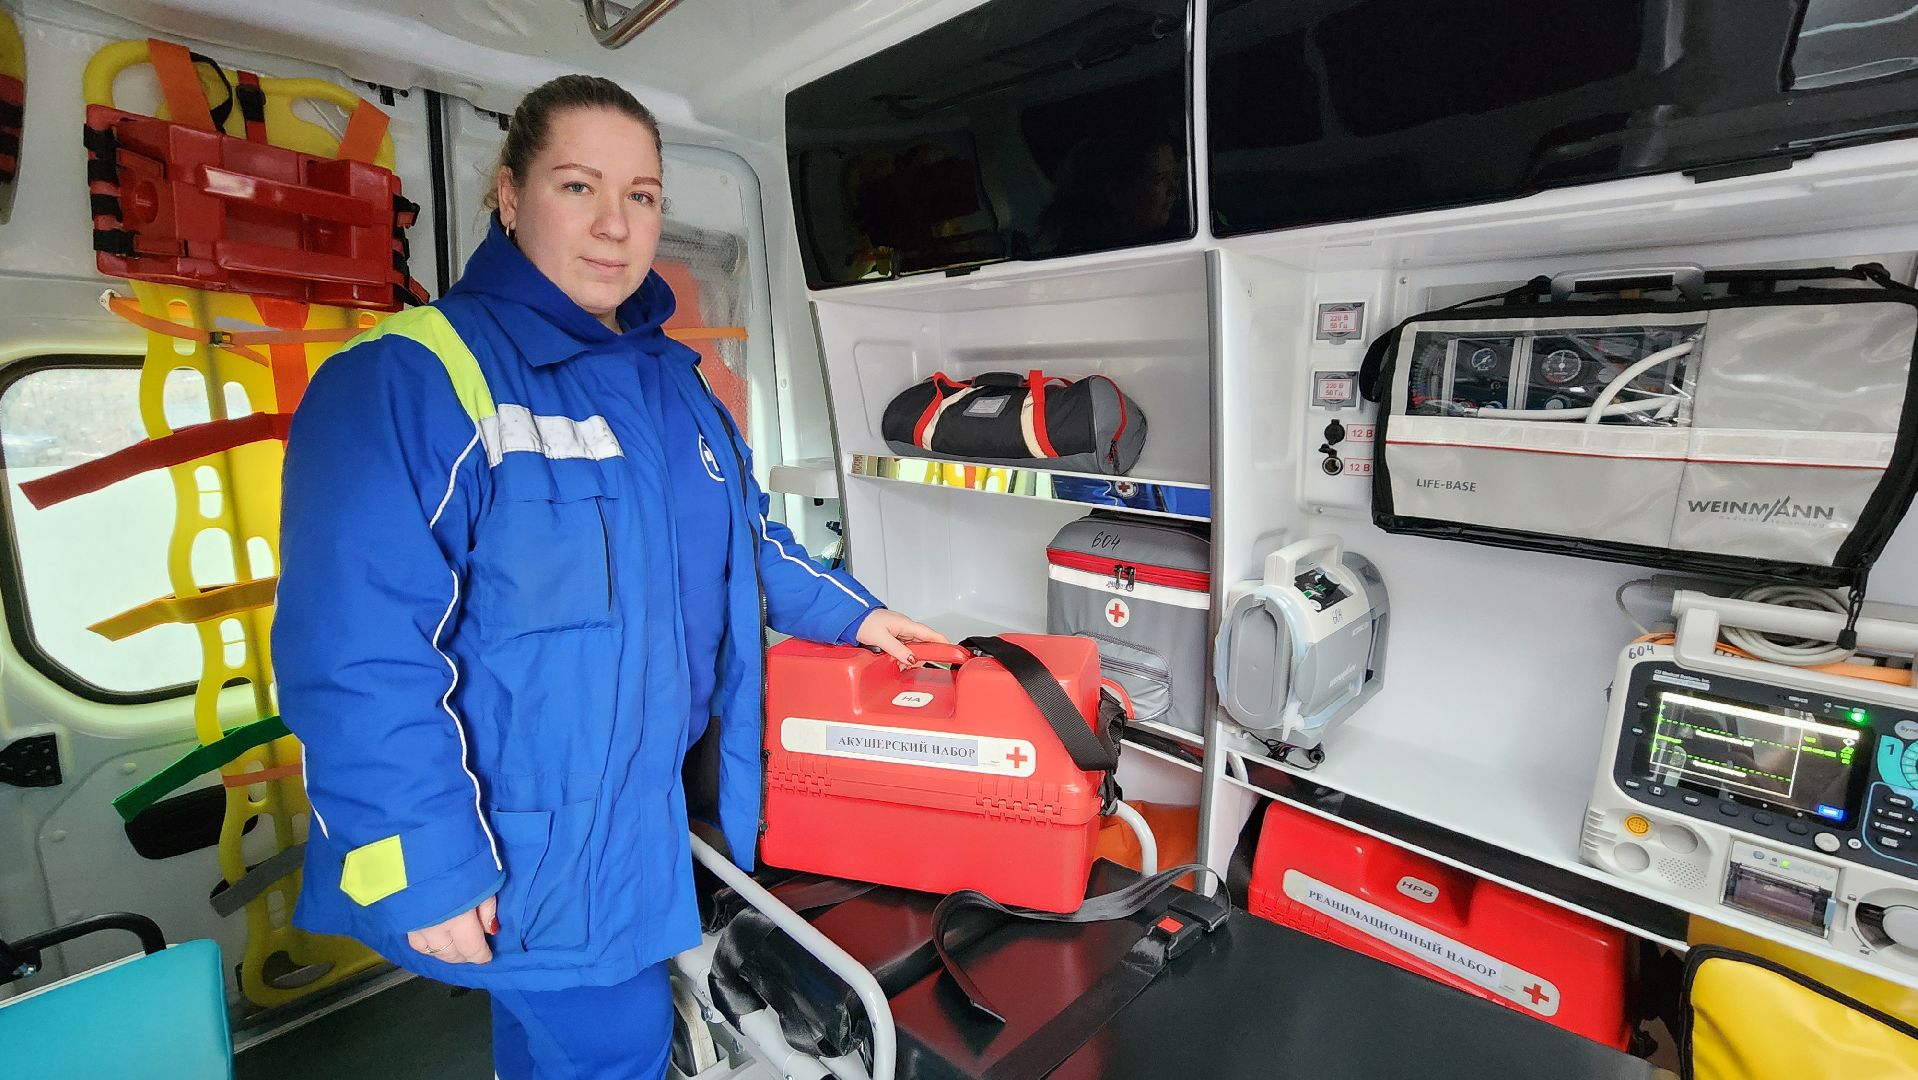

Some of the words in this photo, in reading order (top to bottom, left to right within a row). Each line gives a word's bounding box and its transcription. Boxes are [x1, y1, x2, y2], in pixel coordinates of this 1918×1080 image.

[1351, 429, 1362, 438] 12
[1366, 429, 1373, 438] В
[1349, 463, 1360, 472] 12
[1363, 464, 1370, 472] В
[1416, 478, 1477, 493] LIFE-BASE
[1687, 495, 1834, 523] WEINMANN
[1091, 530, 1121, 551] 604
[1628, 644, 1655, 660] 604
[901, 694, 922, 704] НА
[838, 736, 928, 754] АКУШЕРСКИЙ
[932, 744, 976, 759] НАБОР
[1885, 743, 1895, 756] 1
[1307, 889, 1443, 955] РЕАНИМАЦИОННЫЙ
[1446, 949, 1498, 978] НАБОР
